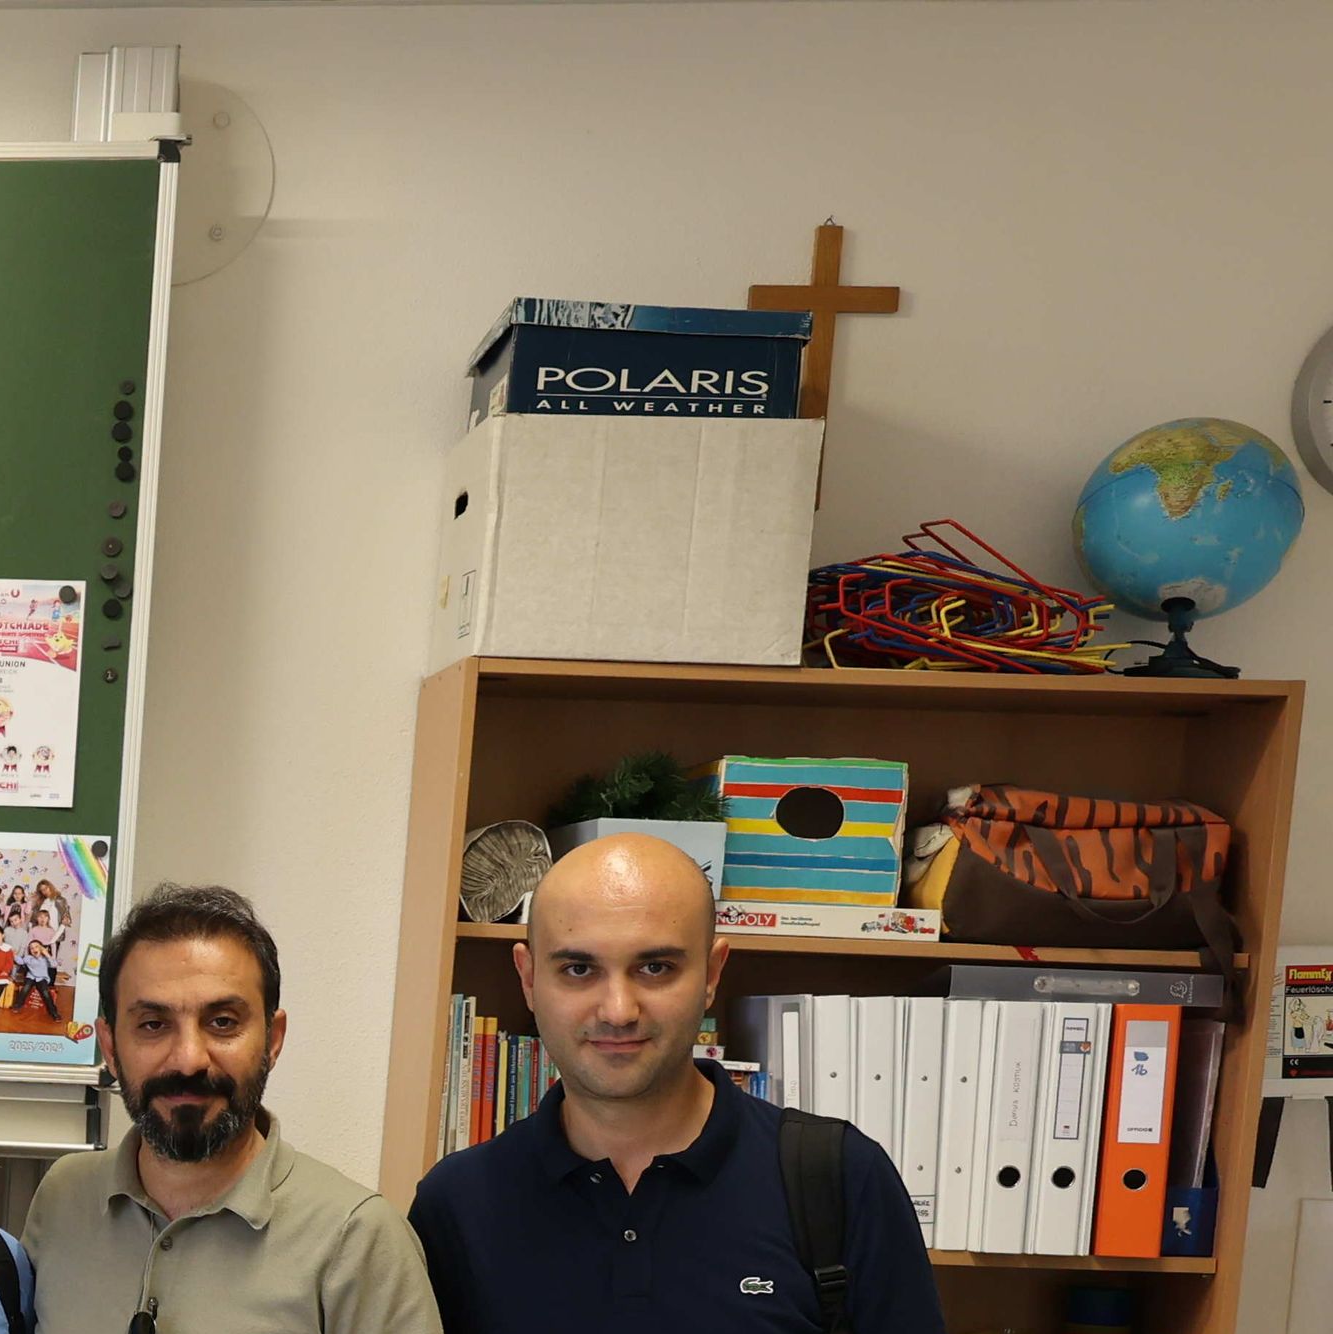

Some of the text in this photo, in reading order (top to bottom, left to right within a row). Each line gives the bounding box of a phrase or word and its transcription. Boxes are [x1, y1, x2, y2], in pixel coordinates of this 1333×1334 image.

[536, 366, 770, 396] POLARIS
[536, 399, 766, 414] ALL WEATHER
